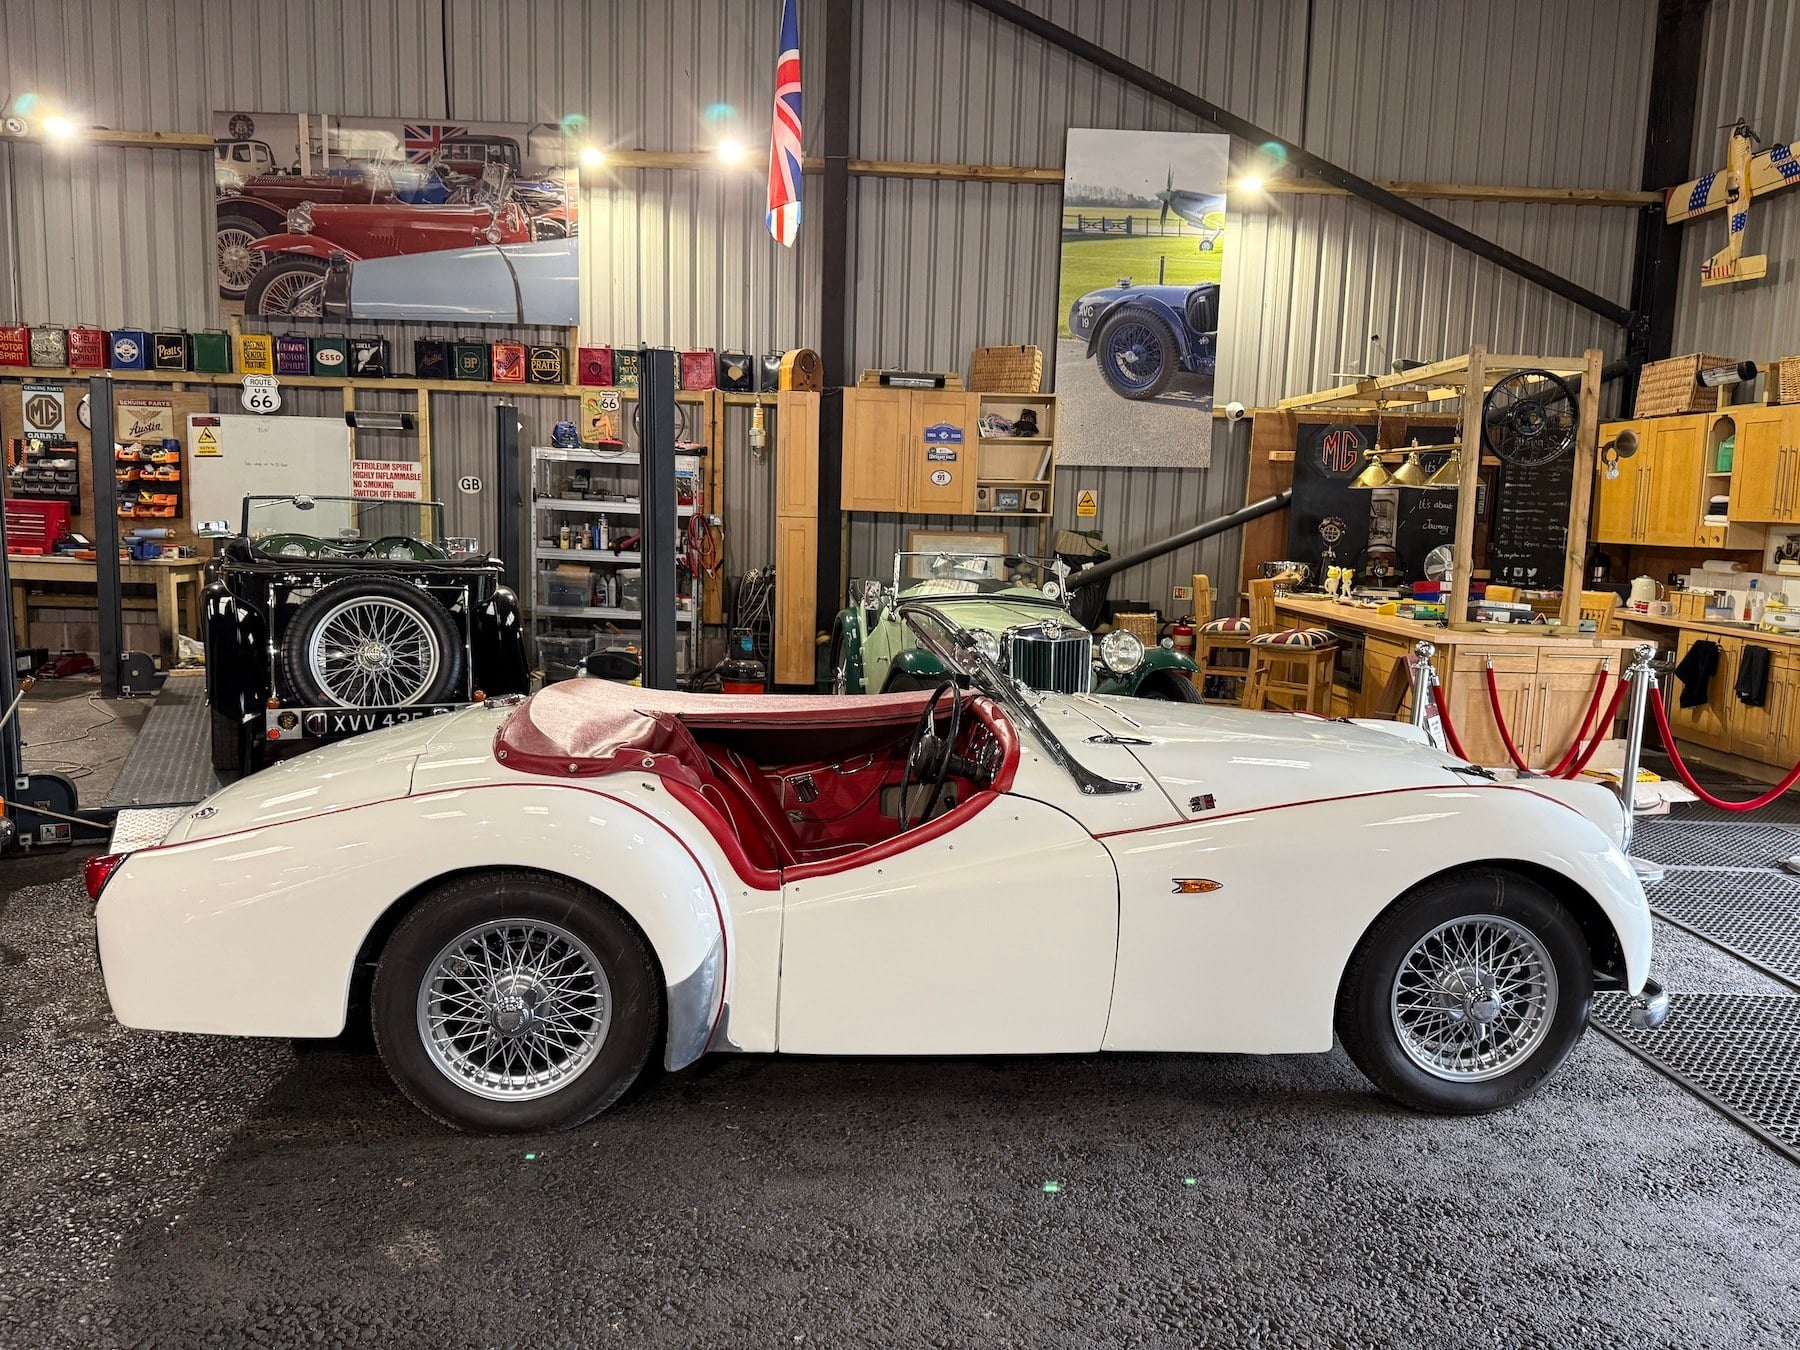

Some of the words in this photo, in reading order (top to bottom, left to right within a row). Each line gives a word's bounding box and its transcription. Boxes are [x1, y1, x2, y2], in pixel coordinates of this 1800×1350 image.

[1079, 305, 1094, 317] AVC
[1081, 317, 1089, 328] 19
[72, 333, 96, 344] SHELL
[72, 345, 97, 353] MOTOR
[0, 351, 24, 360] SPIRIT
[72, 353, 97, 361] SPIRIT
[623, 355, 638, 365] BP
[463, 357, 478, 368] BP
[531, 360, 560, 370] PRATTS
[620, 366, 638, 374] MOTO
[249, 378, 272, 386] ROUTE
[250, 395, 273, 408] 66
[601, 398, 617, 409] 66
[30, 399, 58, 427] MG
[1322, 430, 1358, 472] MG
[352, 461, 391, 471] PETROLEUM
[391, 463, 413, 471] SPIRIT
[352, 471, 375, 479] HIGHLY
[375, 472, 422, 480] INFLAMMABLE
[353, 480, 362, 488] NO
[363, 481, 394, 489] SMOKING
[461, 478, 480, 490] GB
[353, 489, 379, 498] SWITCH
[380, 490, 392, 498] OFF
[393, 491, 417, 499] ENGINE
[1418, 498, 1431, 510] It's
[1433, 501, 1454, 510] about
[334, 714, 376, 732] XVV
